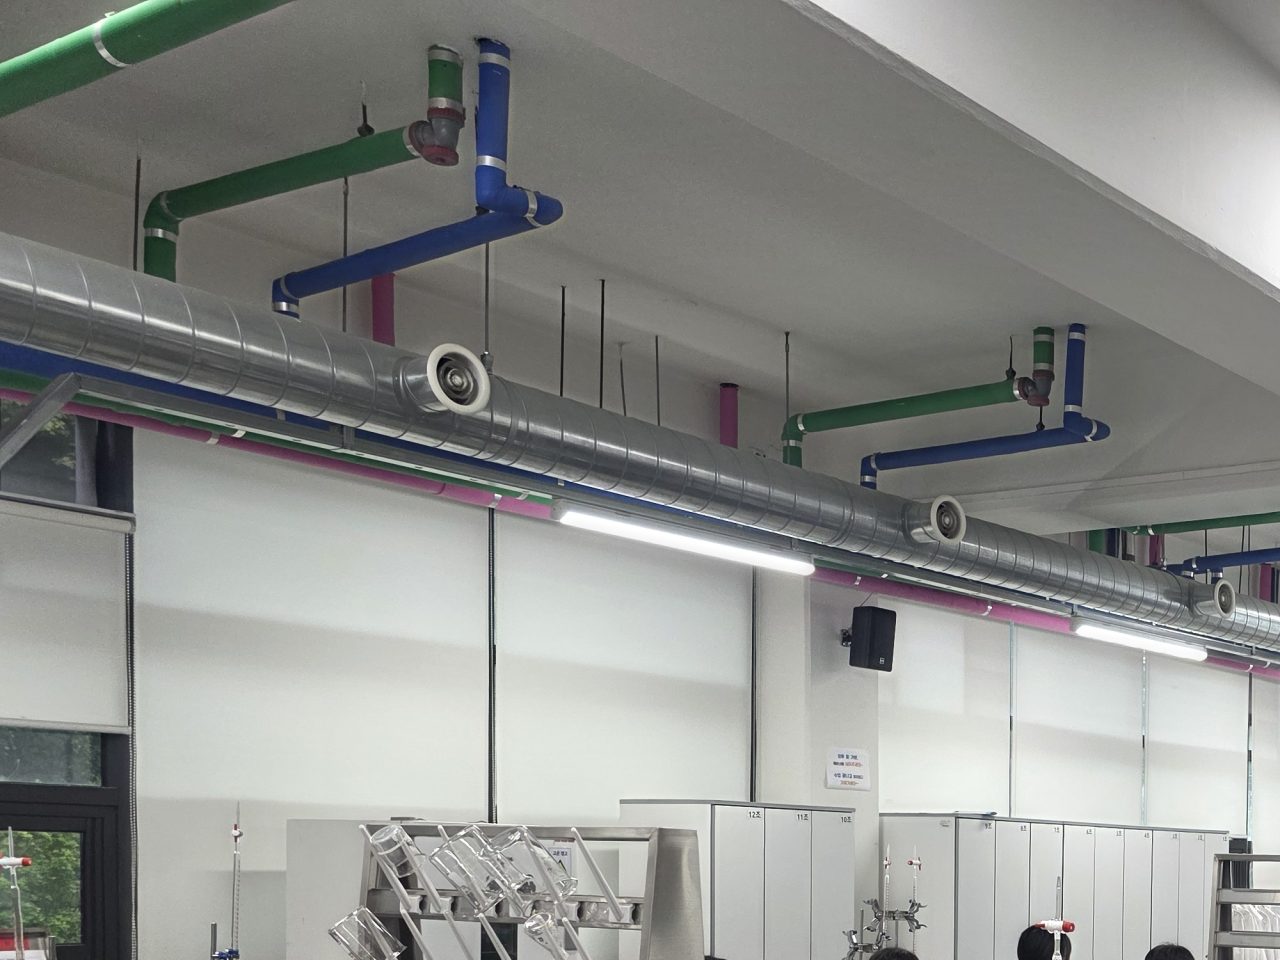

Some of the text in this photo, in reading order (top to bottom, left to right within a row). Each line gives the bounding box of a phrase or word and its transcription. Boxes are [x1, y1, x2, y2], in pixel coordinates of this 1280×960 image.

[748, 811, 762, 819] 12조
[797, 813, 808, 821] 11조
[840, 815, 852, 823] 10조
[984, 822, 993, 830] 9조
